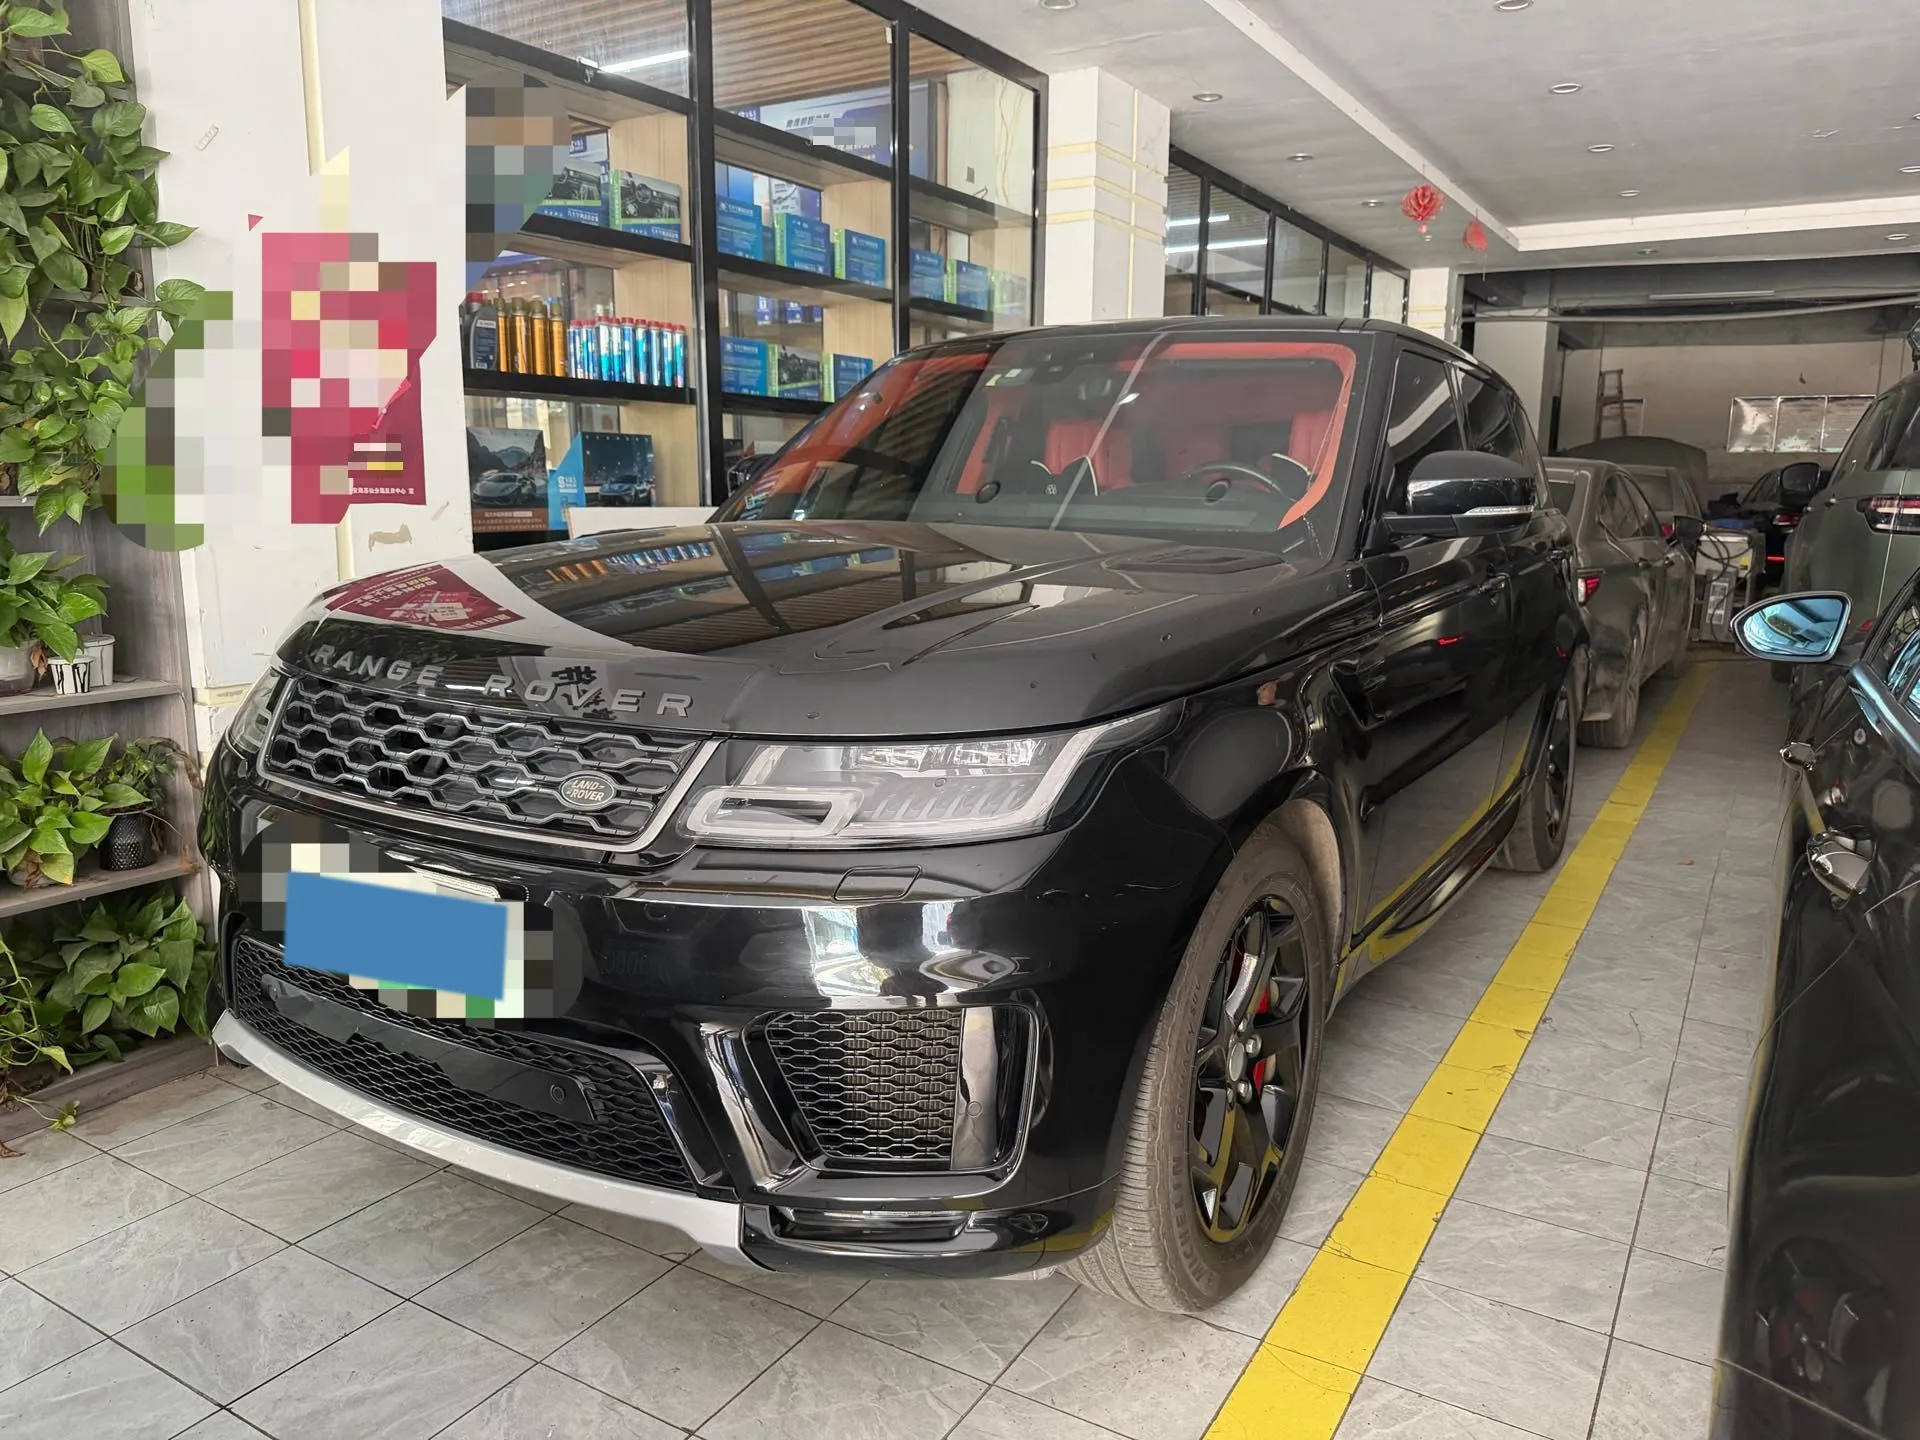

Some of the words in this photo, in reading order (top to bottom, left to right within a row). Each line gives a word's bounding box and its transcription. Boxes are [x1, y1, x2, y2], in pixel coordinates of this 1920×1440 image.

[313, 643, 445, 688] RANGE
[482, 673, 694, 718] ROVER
[570, 789, 605, 801] ROVER
[1170, 1155, 1207, 1282] MICHELIN
